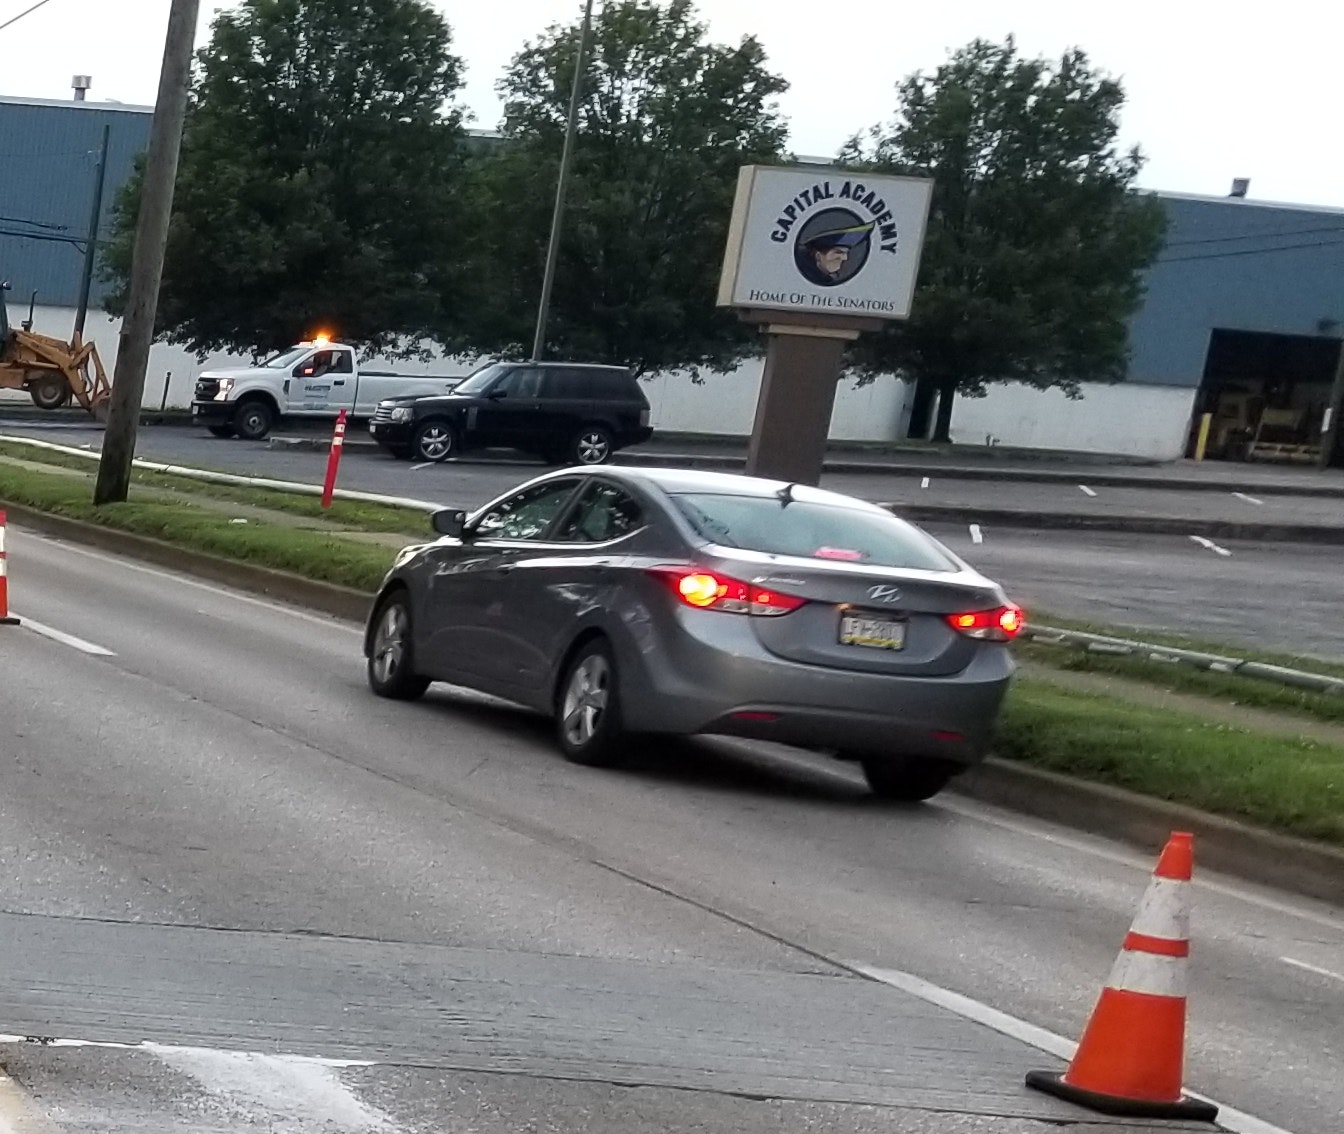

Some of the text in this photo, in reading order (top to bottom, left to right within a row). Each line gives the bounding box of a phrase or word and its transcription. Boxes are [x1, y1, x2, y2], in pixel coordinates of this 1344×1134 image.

[770, 181, 899, 255] CAPITAL ACADEMY
[749, 289, 896, 312] HOME OF THE SENATORS
